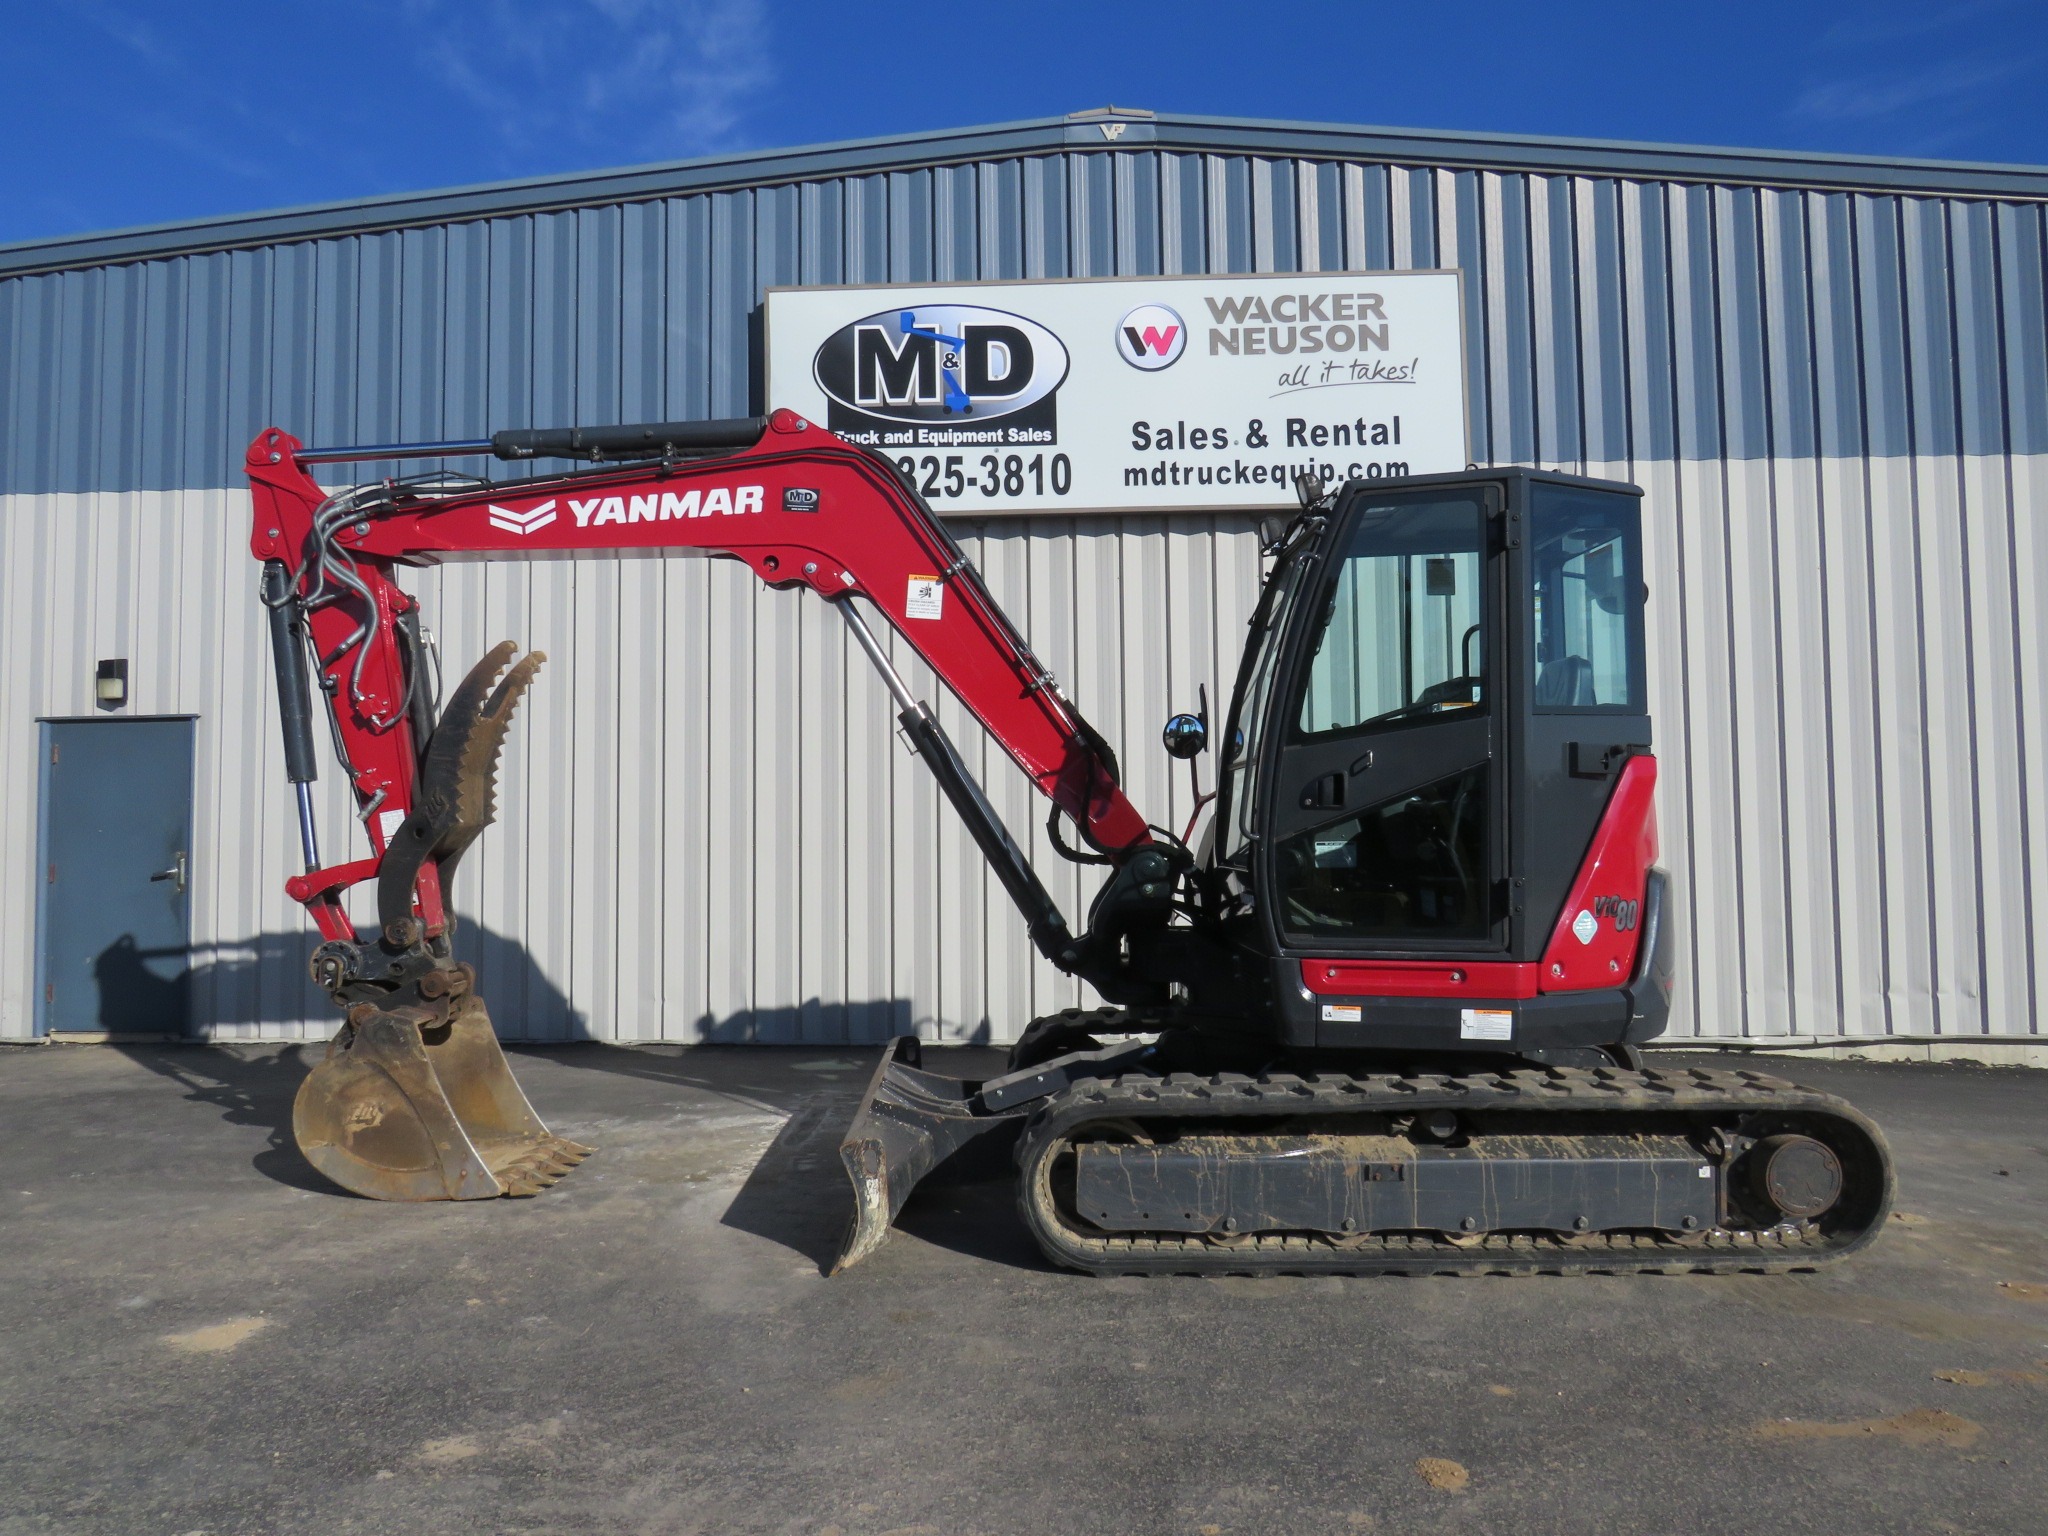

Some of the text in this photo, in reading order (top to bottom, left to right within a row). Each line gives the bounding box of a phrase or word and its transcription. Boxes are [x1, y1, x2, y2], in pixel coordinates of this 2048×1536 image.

[1203, 293, 1388, 324] WACKER
[1209, 324, 1390, 356] NEUSON
[1278, 357, 1419, 387] all it takes!
[884, 429, 914, 444] and
[918, 427, 1004, 447] Equipment
[1007, 427, 1053, 443] Sales
[1131, 415, 1402, 451] Sales & Rental
[1123, 457, 1410, 490] mdtruckequip.com
[567, 485, 765, 528] YANMAR
